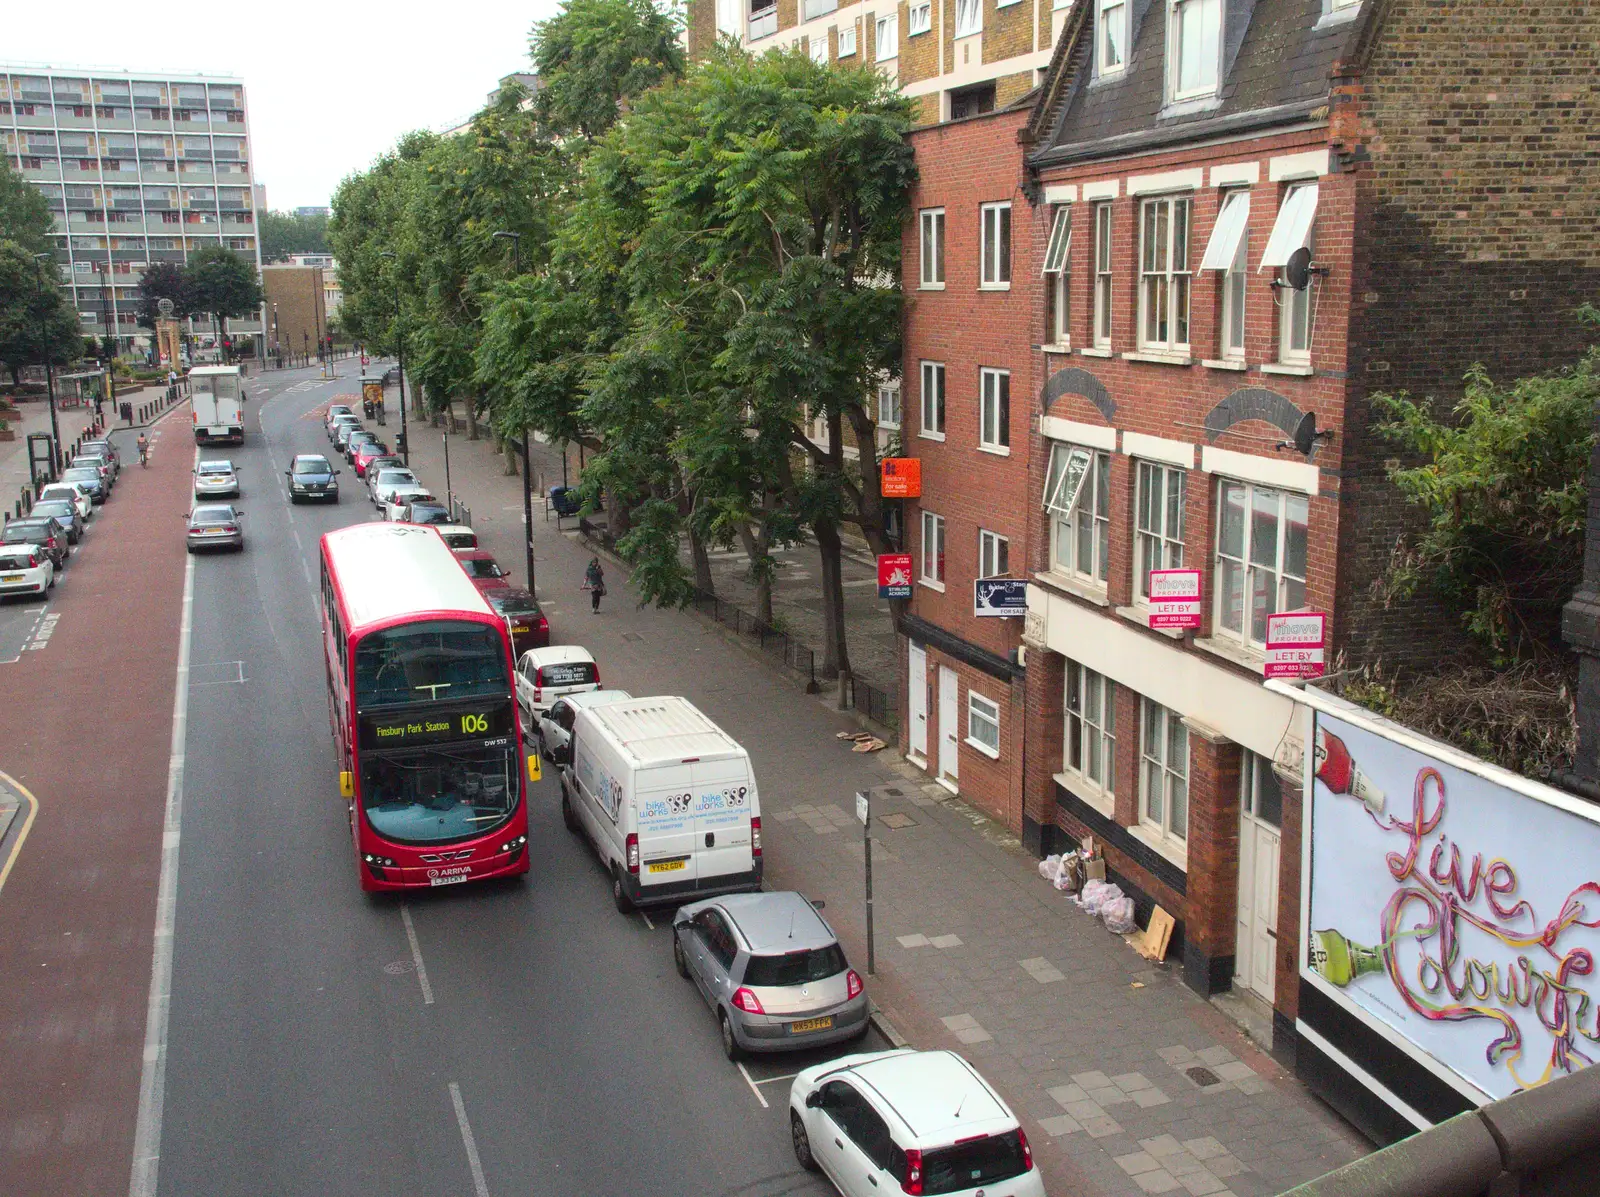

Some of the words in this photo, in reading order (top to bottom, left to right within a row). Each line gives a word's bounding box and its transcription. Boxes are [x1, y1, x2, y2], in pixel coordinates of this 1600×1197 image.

[1157, 580, 1196, 589] move
[1158, 604, 1175, 612] LET
[1178, 604, 1191, 612] BY
[1277, 624, 1319, 635] move
[1276, 652, 1295, 660] LET
[1299, 652, 1312, 661] BY
[461, 713, 488, 734] 106
[377, 726, 404, 737] Finsbury
[407, 724, 423, 734] Park
[426, 721, 449, 732] Station
[702, 794, 721, 802] bike
[646, 801, 665, 810] bike
[696, 801, 724, 811] works
[640, 808, 669, 818] works
[1386, 766, 1526, 920] Live
[440, 866, 472, 876] ARRIVA
[652, 863, 669, 871] YY62
[1317, 951, 1328, 963] B
[1381, 887, 1600, 1072] Colourfu
[793, 1020, 813, 1030] RX53
